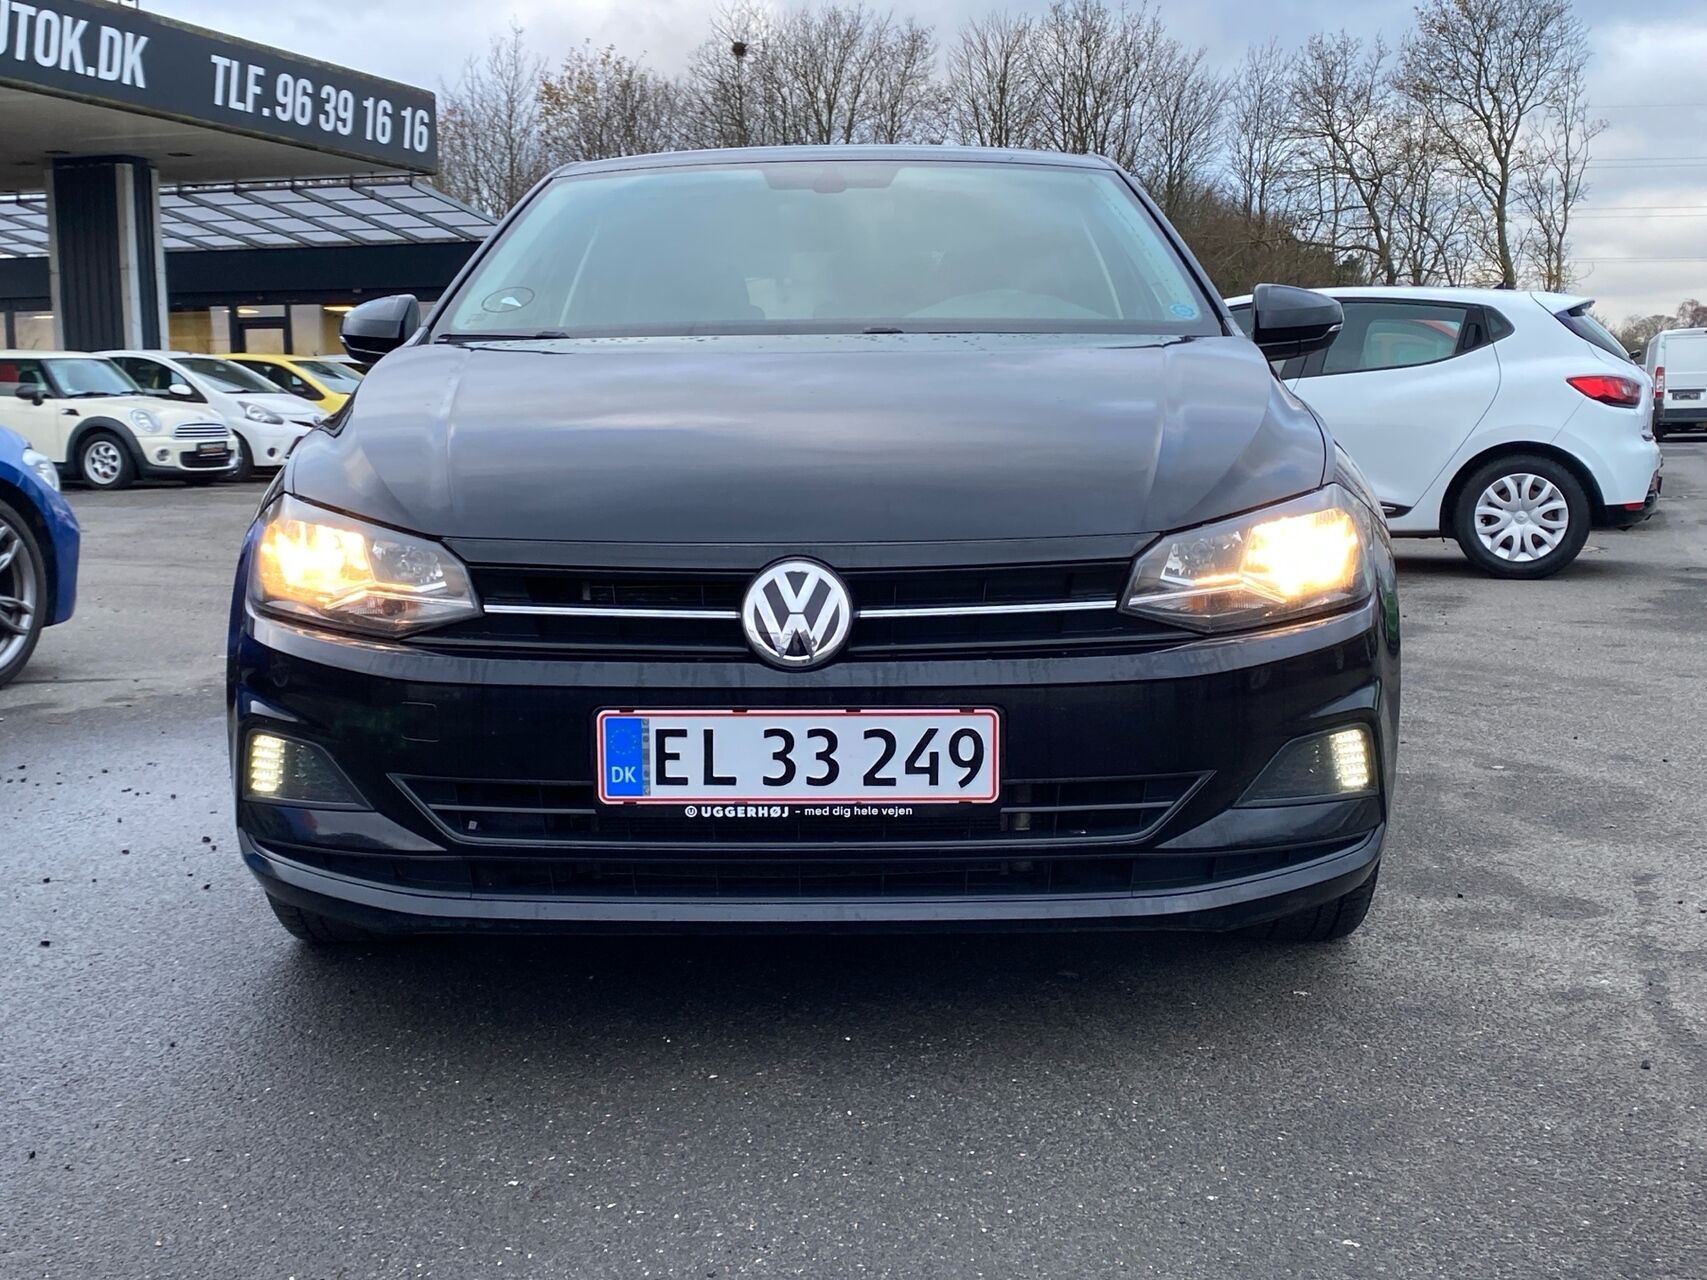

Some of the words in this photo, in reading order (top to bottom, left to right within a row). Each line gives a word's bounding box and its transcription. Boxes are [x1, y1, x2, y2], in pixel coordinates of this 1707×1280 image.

[210, 54, 271, 117] TLF.
[275, 73, 314, 126] 96
[319, 85, 354, 136] 39
[362, 96, 393, 145] 16
[401, 106, 430, 153] 16
[611, 766, 637, 784] DK
[655, 728, 737, 786] EL
[762, 728, 840, 787] 33
[863, 728, 985, 789] 249
[701, 805, 790, 818] UGGERHØJ
[804, 806, 830, 816] med
[833, 806, 851, 818] dig
[854, 806, 878, 816] hele
[881, 806, 913, 818] vejen
